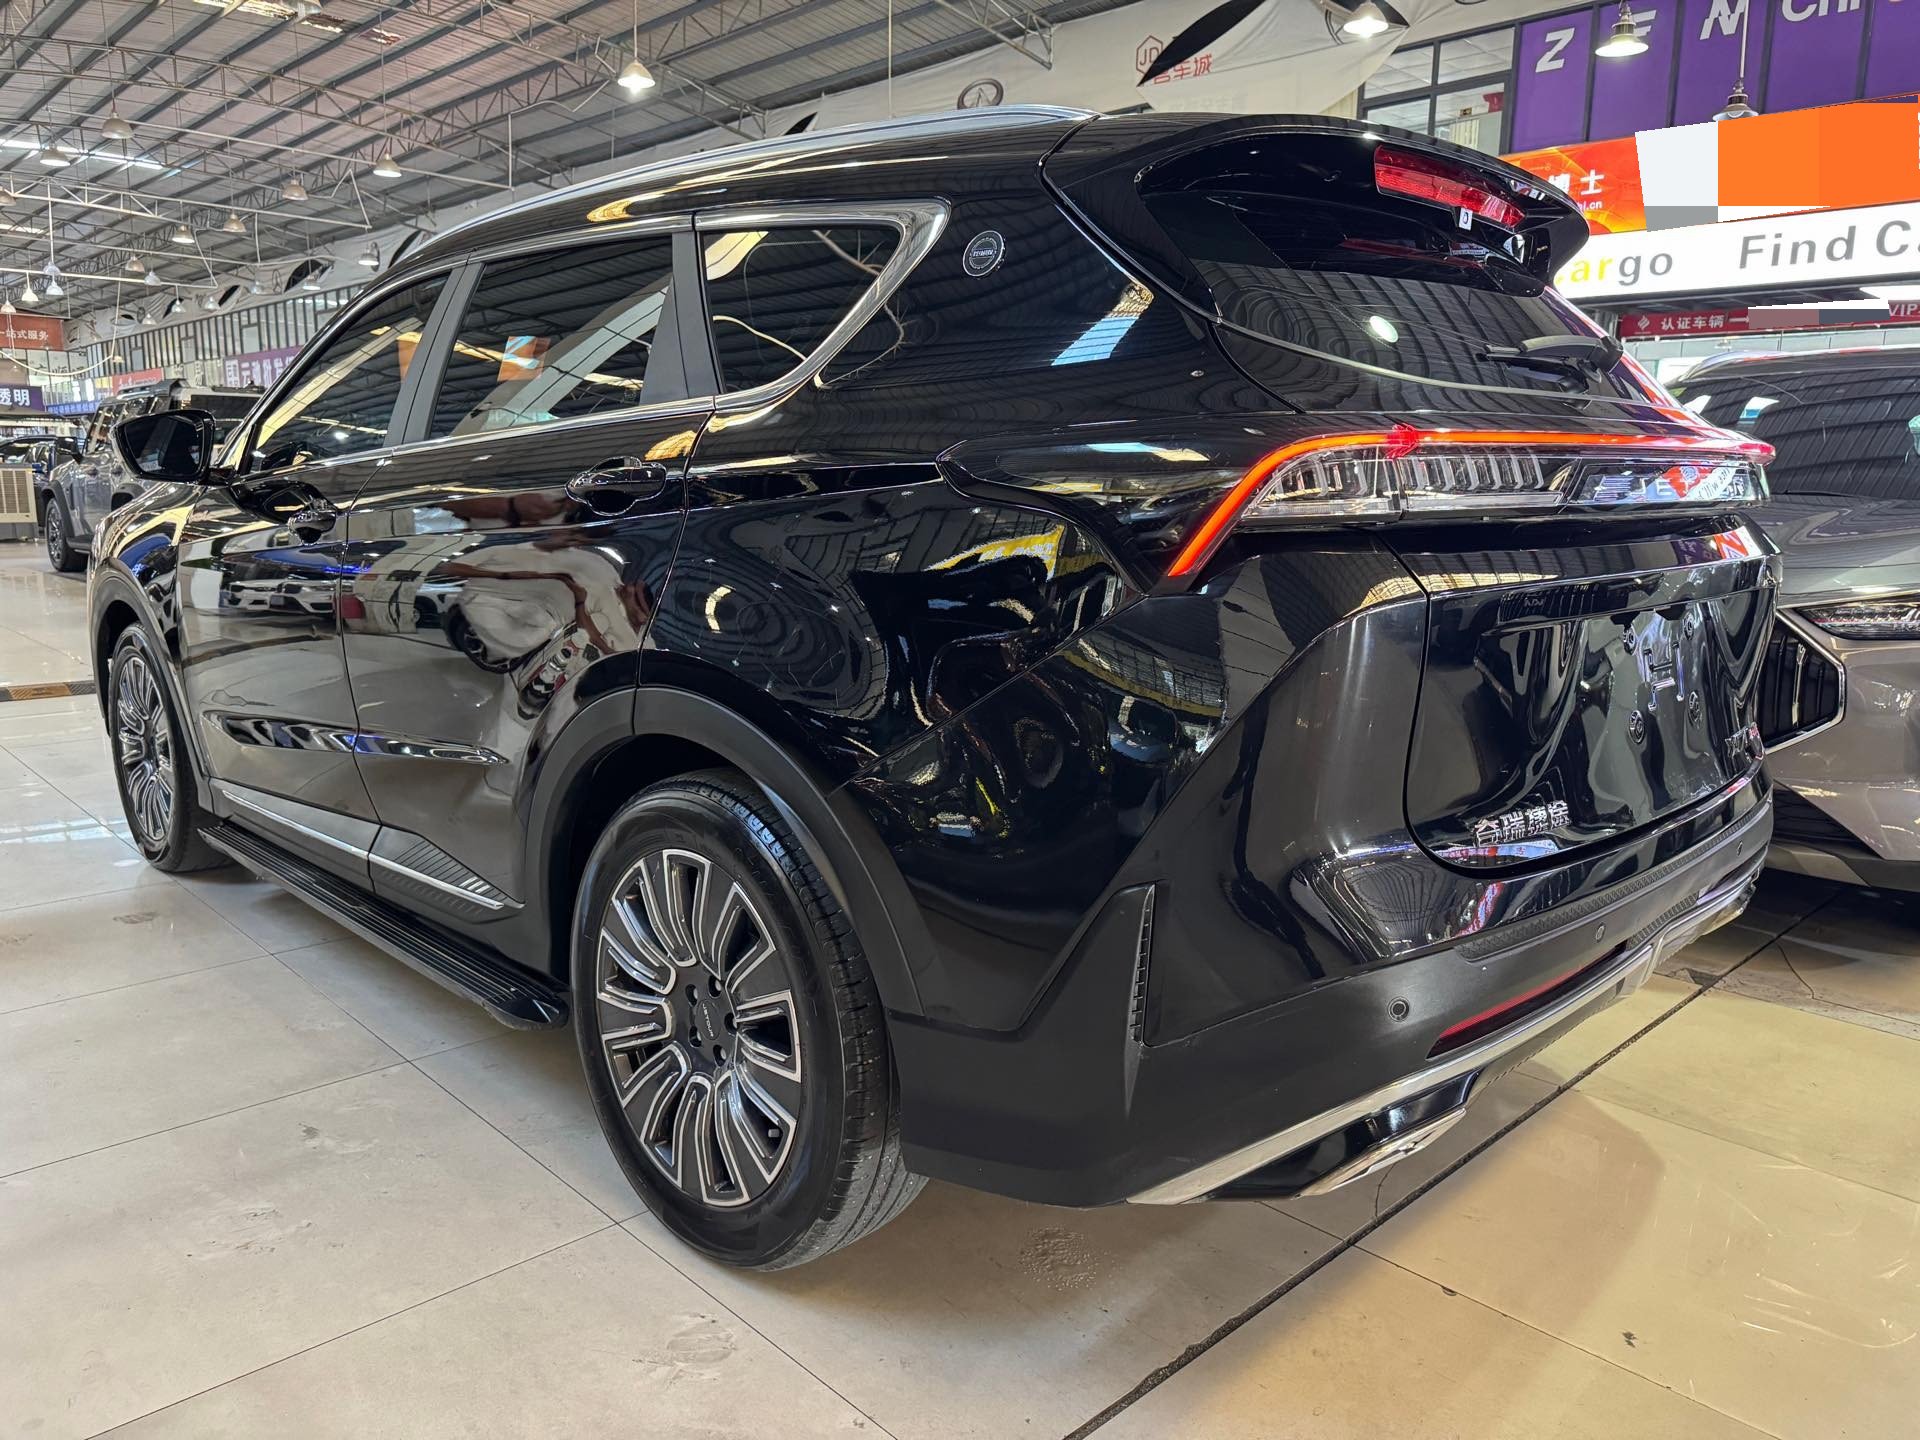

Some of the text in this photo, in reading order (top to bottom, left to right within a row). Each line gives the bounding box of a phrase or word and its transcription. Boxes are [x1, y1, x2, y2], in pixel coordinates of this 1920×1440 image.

[1555, 220, 1920, 286] argo Find C
[1660, 314, 1725, 331] 认证车辆
